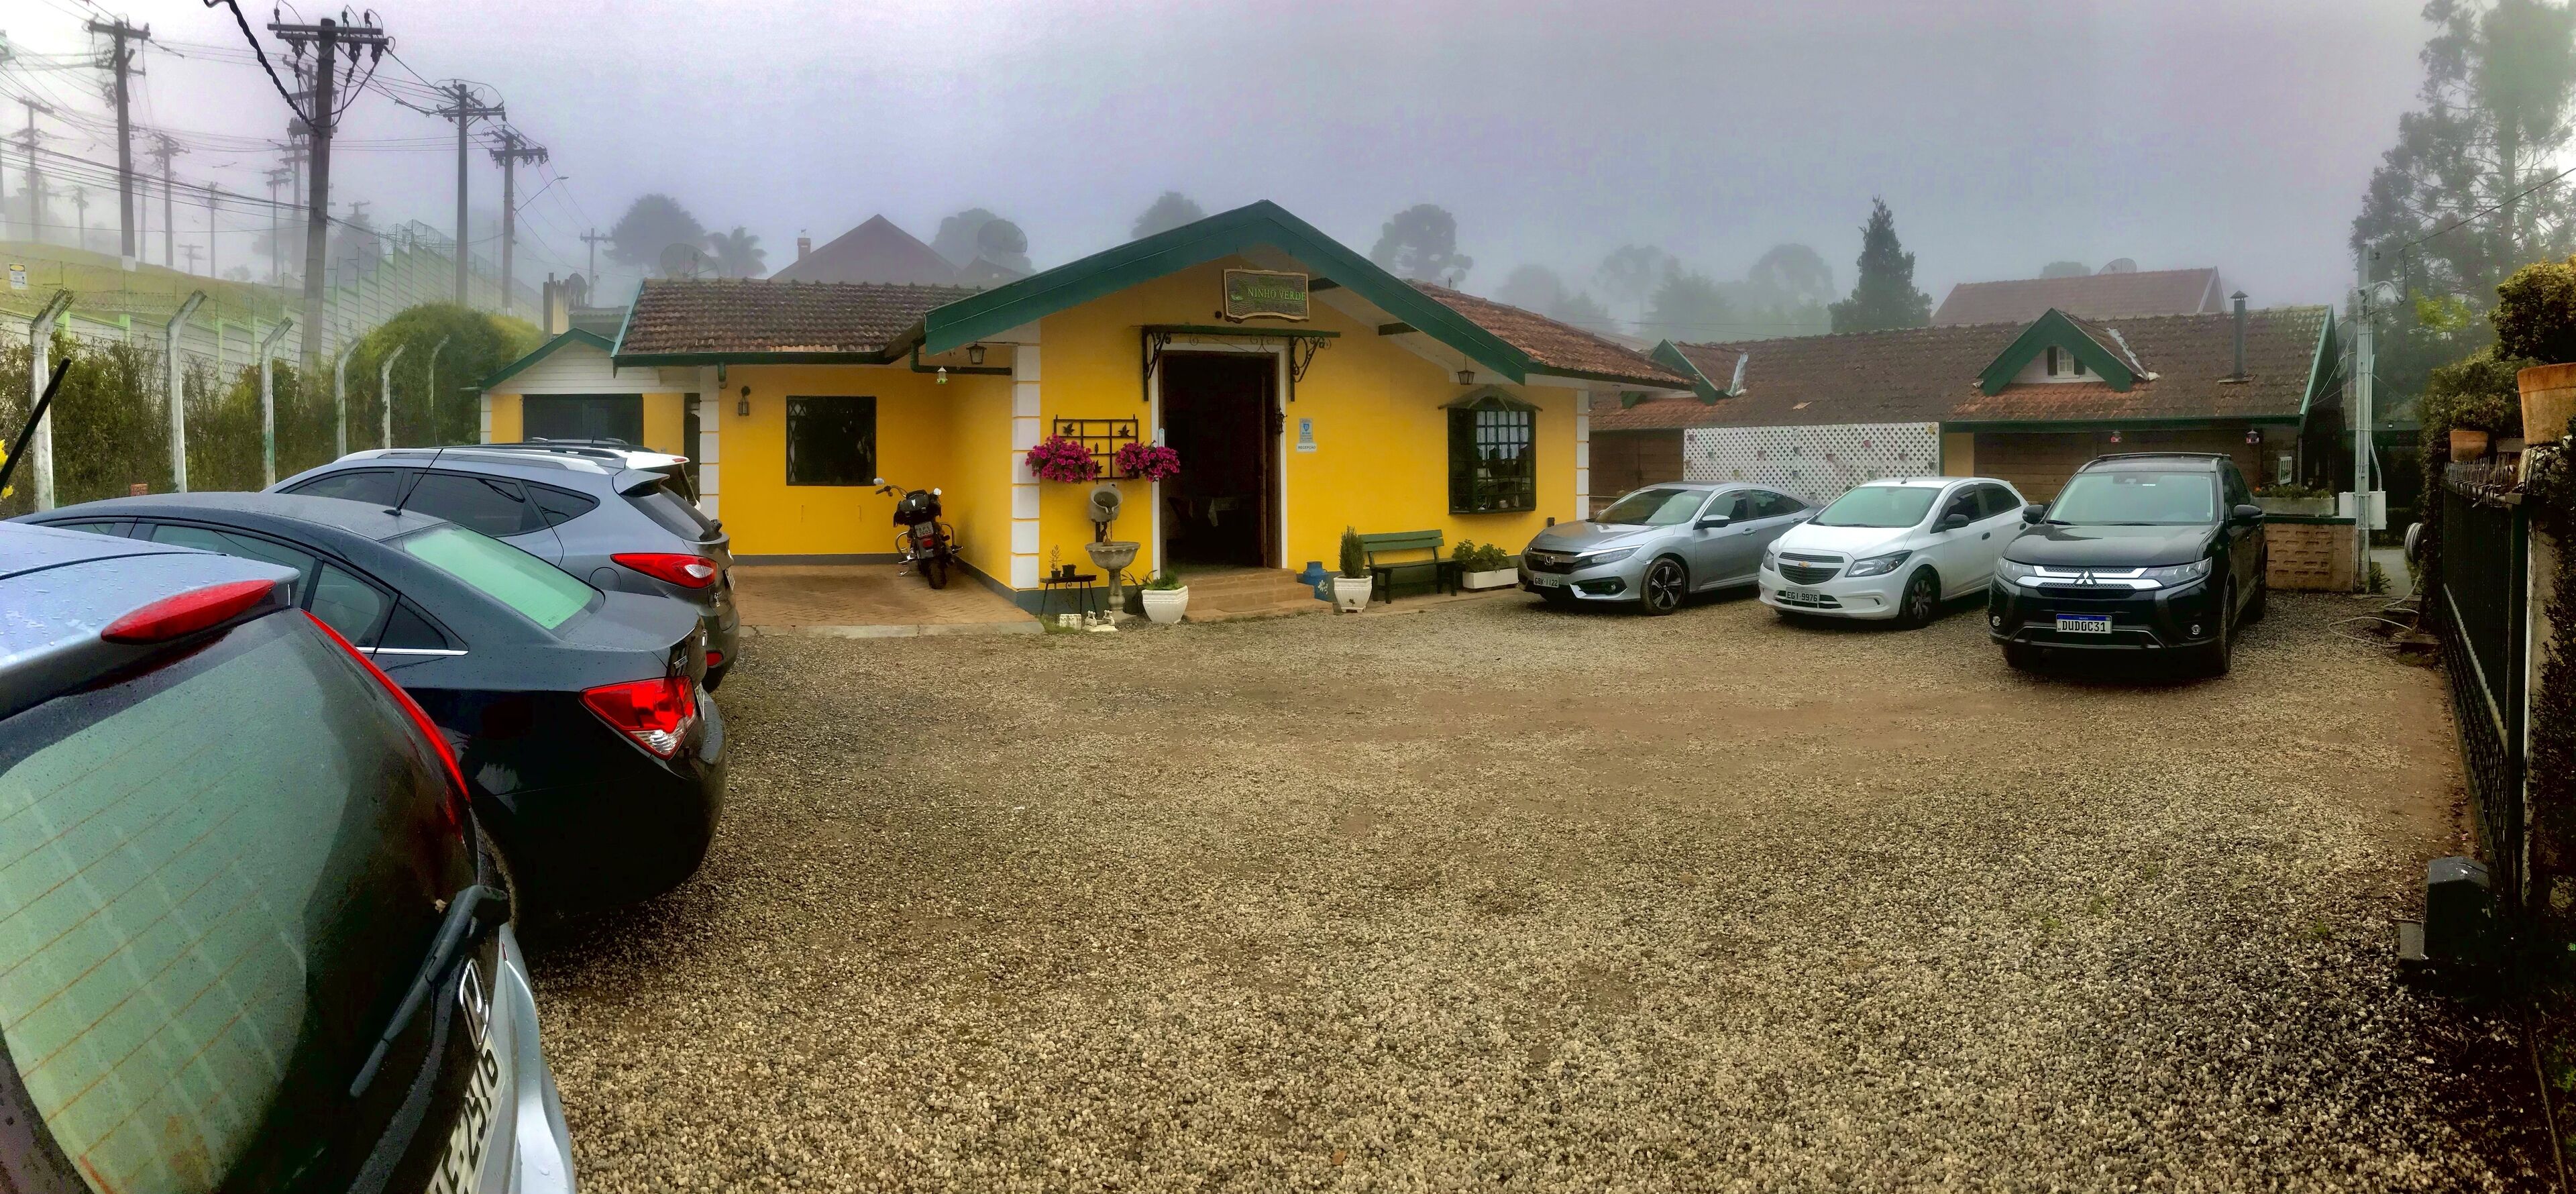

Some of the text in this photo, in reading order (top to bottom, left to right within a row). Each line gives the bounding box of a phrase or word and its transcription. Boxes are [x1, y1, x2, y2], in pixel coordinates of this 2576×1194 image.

[1248, 288, 1306, 301] NINHO VERDE
[1787, 592, 1817, 602] EGI-9976
